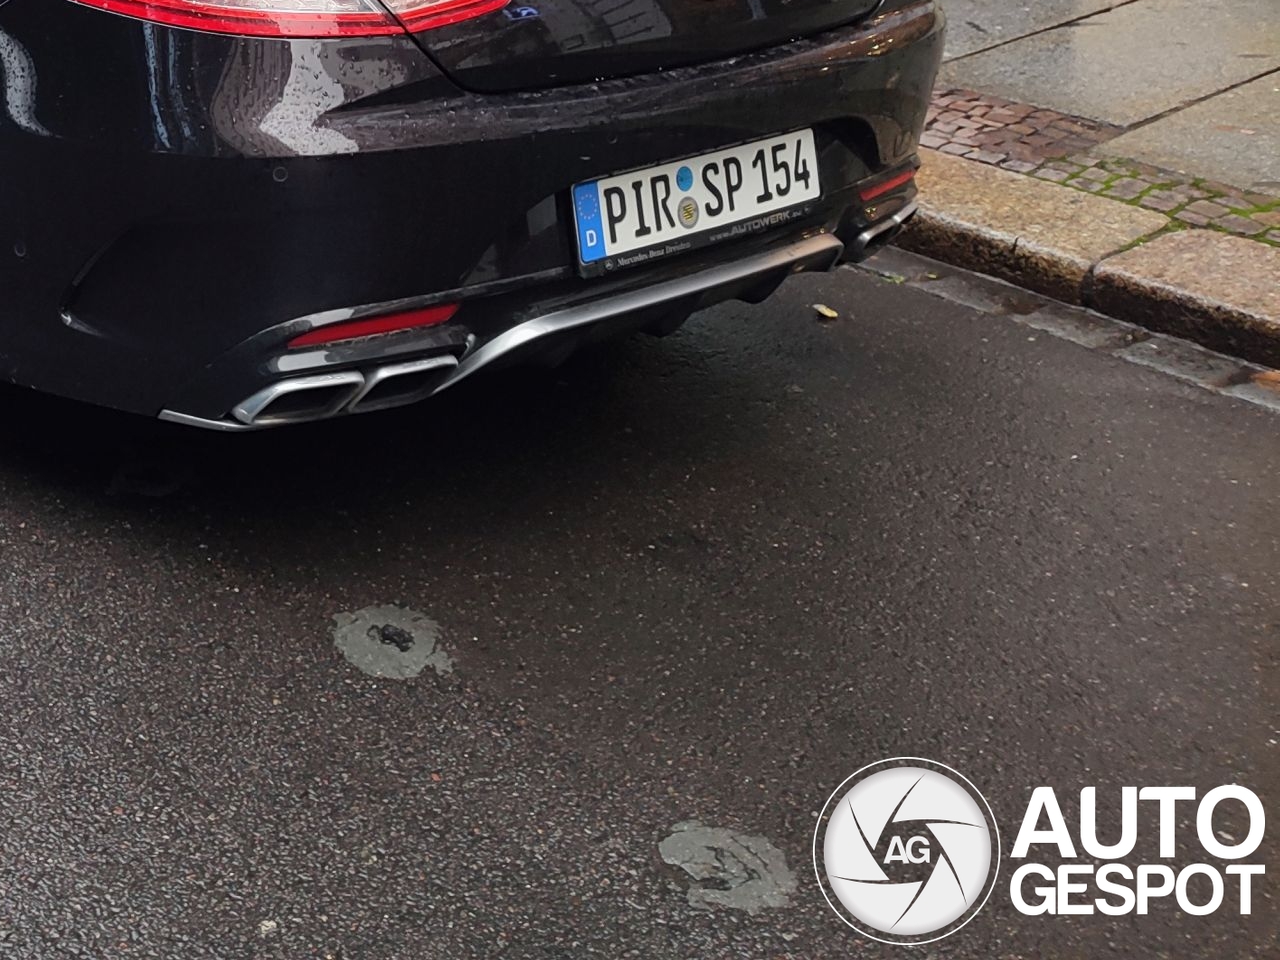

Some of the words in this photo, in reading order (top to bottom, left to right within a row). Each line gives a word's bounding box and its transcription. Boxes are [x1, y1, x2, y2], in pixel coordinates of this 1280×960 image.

[603, 174, 676, 244] PIR
[701, 156, 742, 217] SP
[752, 139, 810, 203] 154
[586, 230, 597, 247] D
